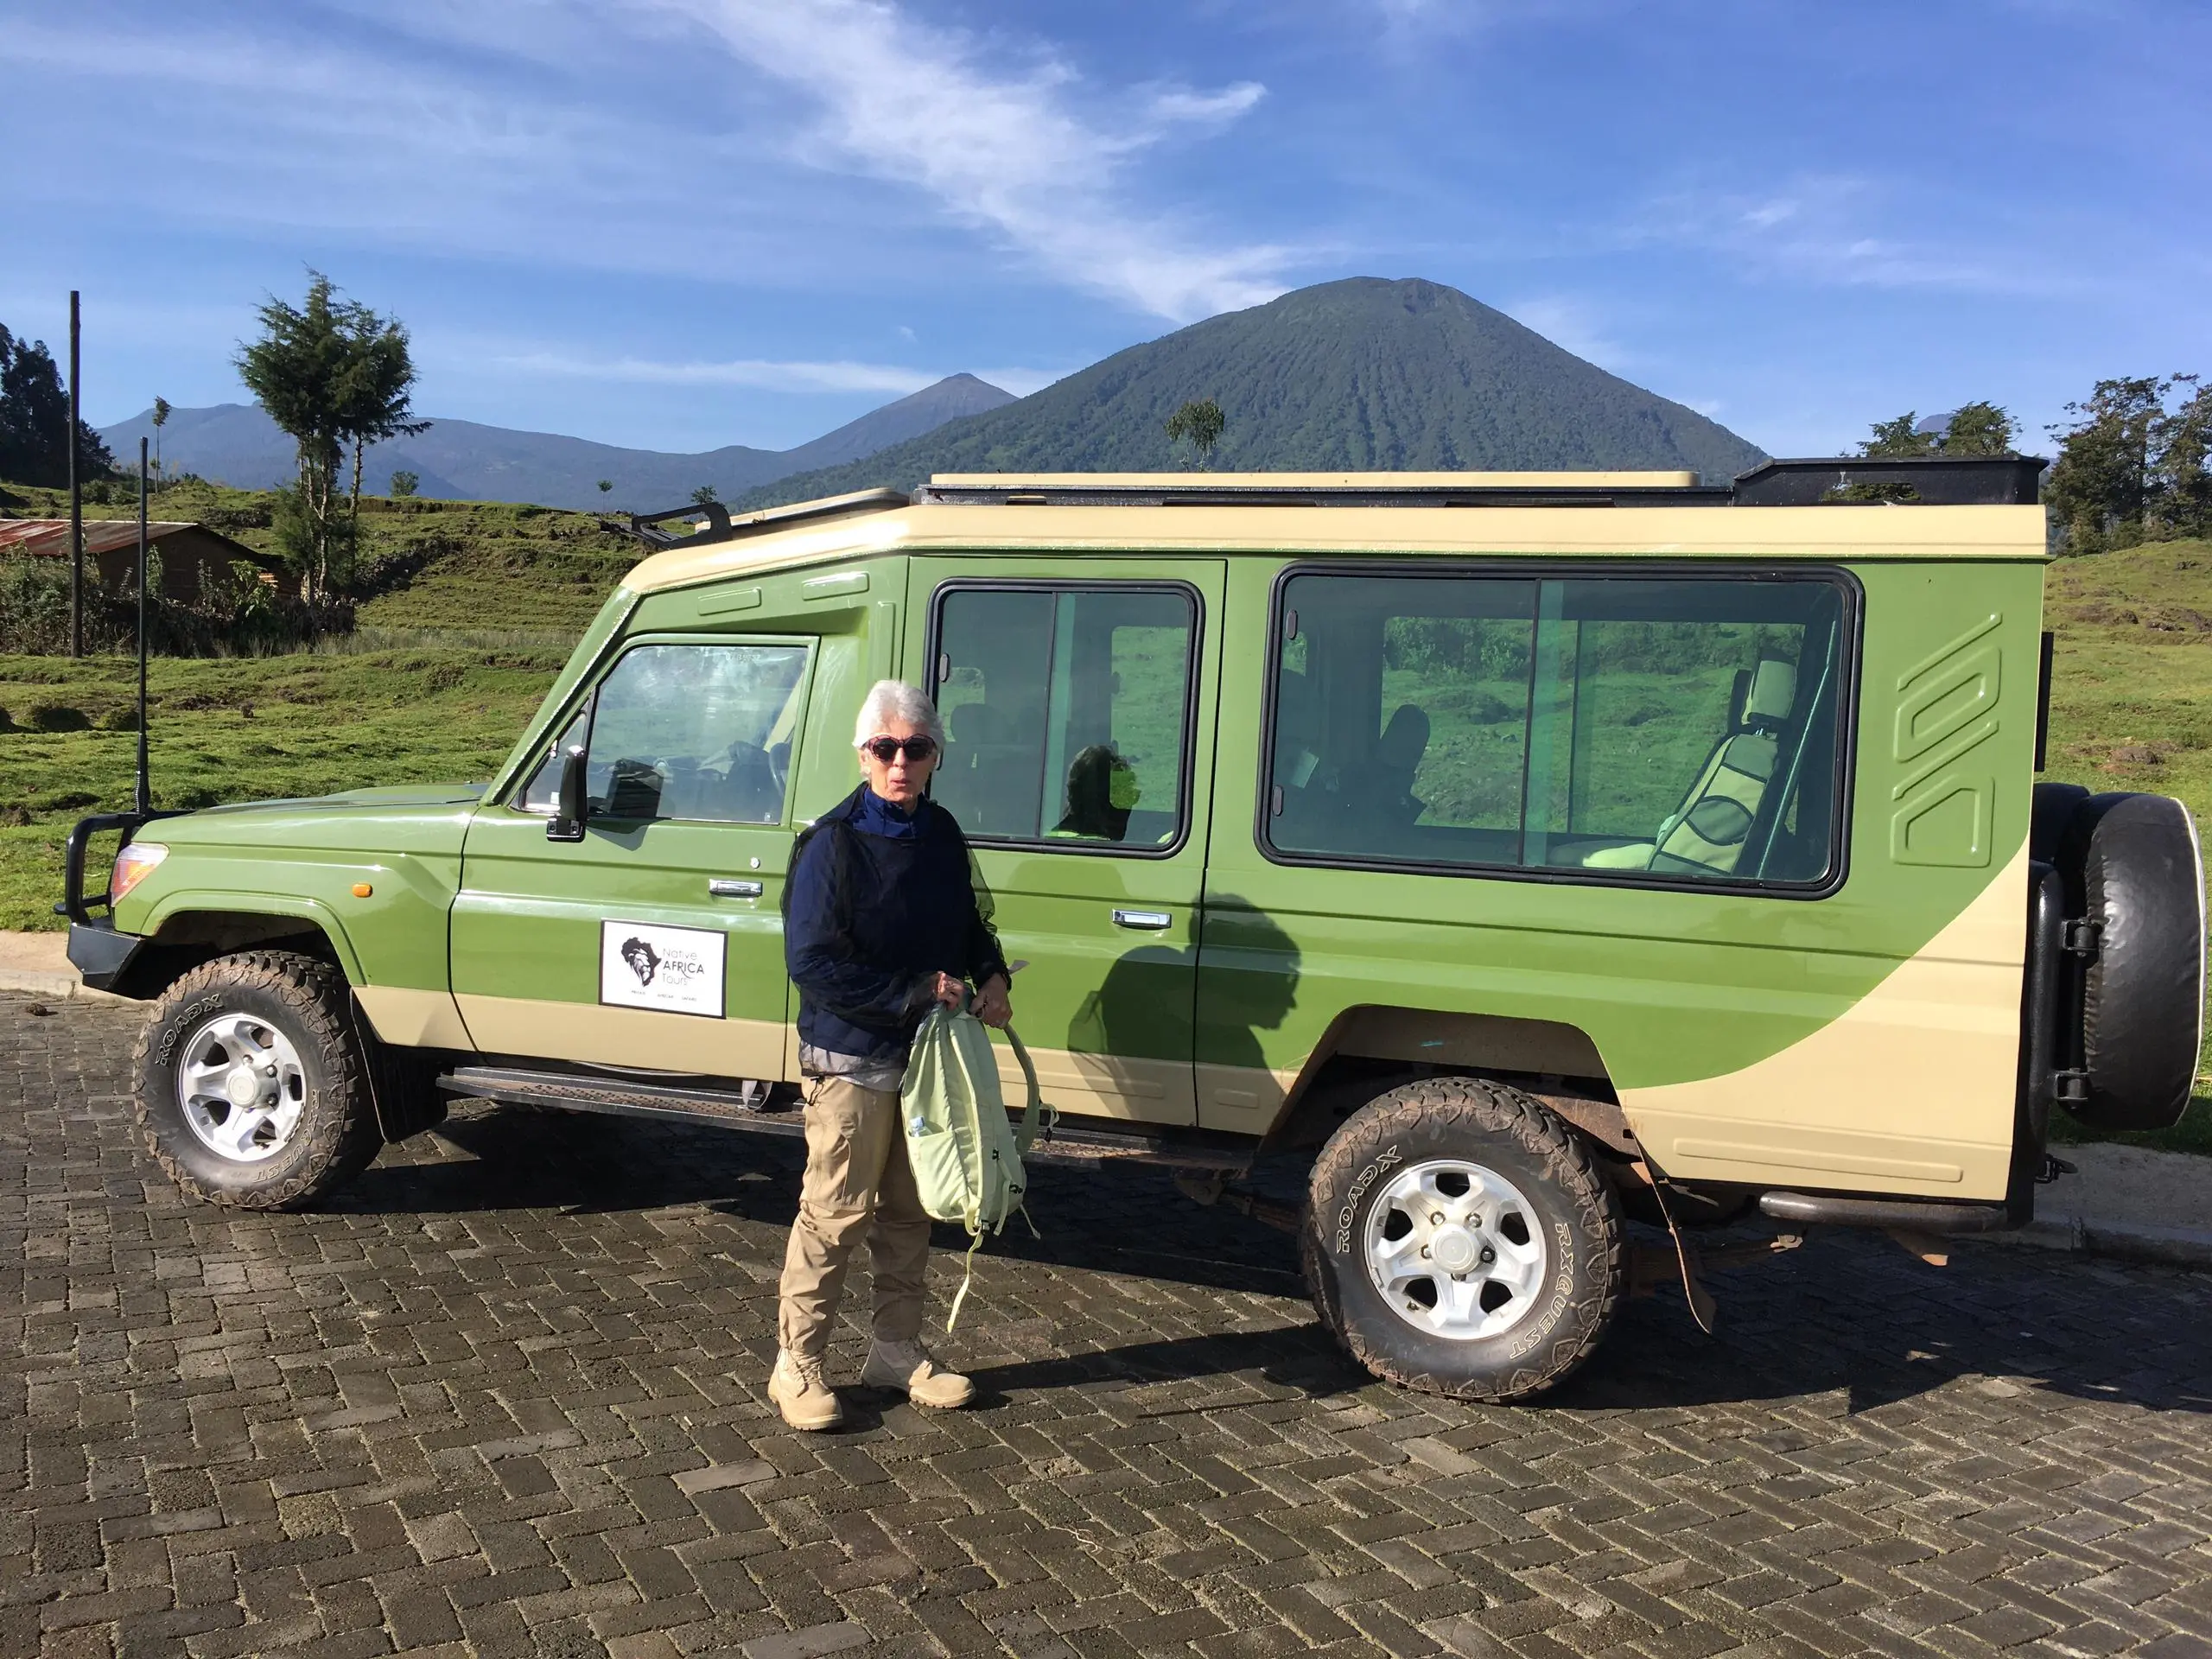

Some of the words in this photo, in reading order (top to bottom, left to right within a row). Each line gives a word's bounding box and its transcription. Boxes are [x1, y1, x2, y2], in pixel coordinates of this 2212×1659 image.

[663, 948, 698, 961] Native
[663, 960, 705, 977] AFRICA
[662, 973, 689, 986] Tours
[156, 993, 224, 1067] ROADX
[1336, 1144, 1403, 1255] ROADX
[1510, 1222, 1576, 1359] RXQUEST
